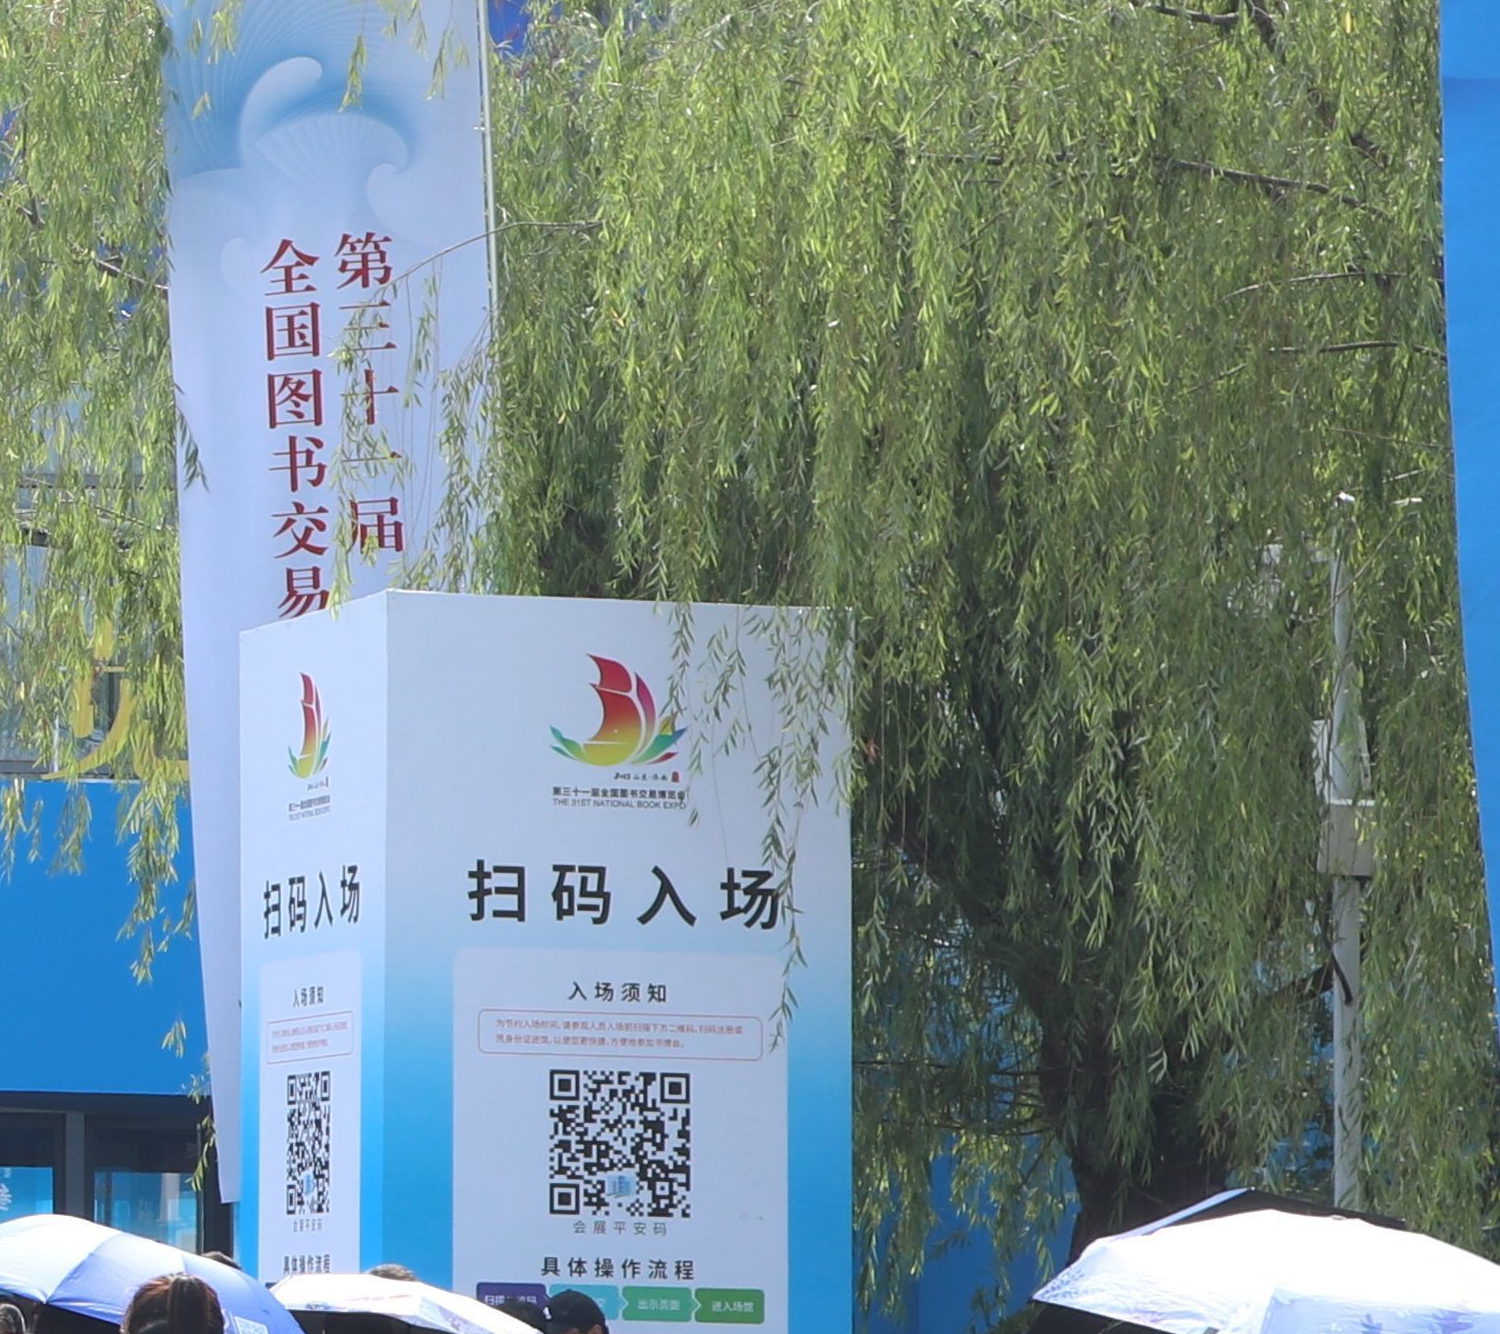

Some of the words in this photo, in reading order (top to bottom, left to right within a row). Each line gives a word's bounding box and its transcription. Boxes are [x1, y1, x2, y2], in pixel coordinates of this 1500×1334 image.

[259, 237, 331, 619] 全国图书交易
[263, 864, 361, 940] 扫码入场
[467, 858, 783, 931] 扫码入场
[567, 980, 668, 1003] 入场须知
[573, 1219, 668, 1237] 会展平安码
[541, 1256, 696, 1281] 具体操作流程
[711, 1300, 755, 1314] 进入场馆
